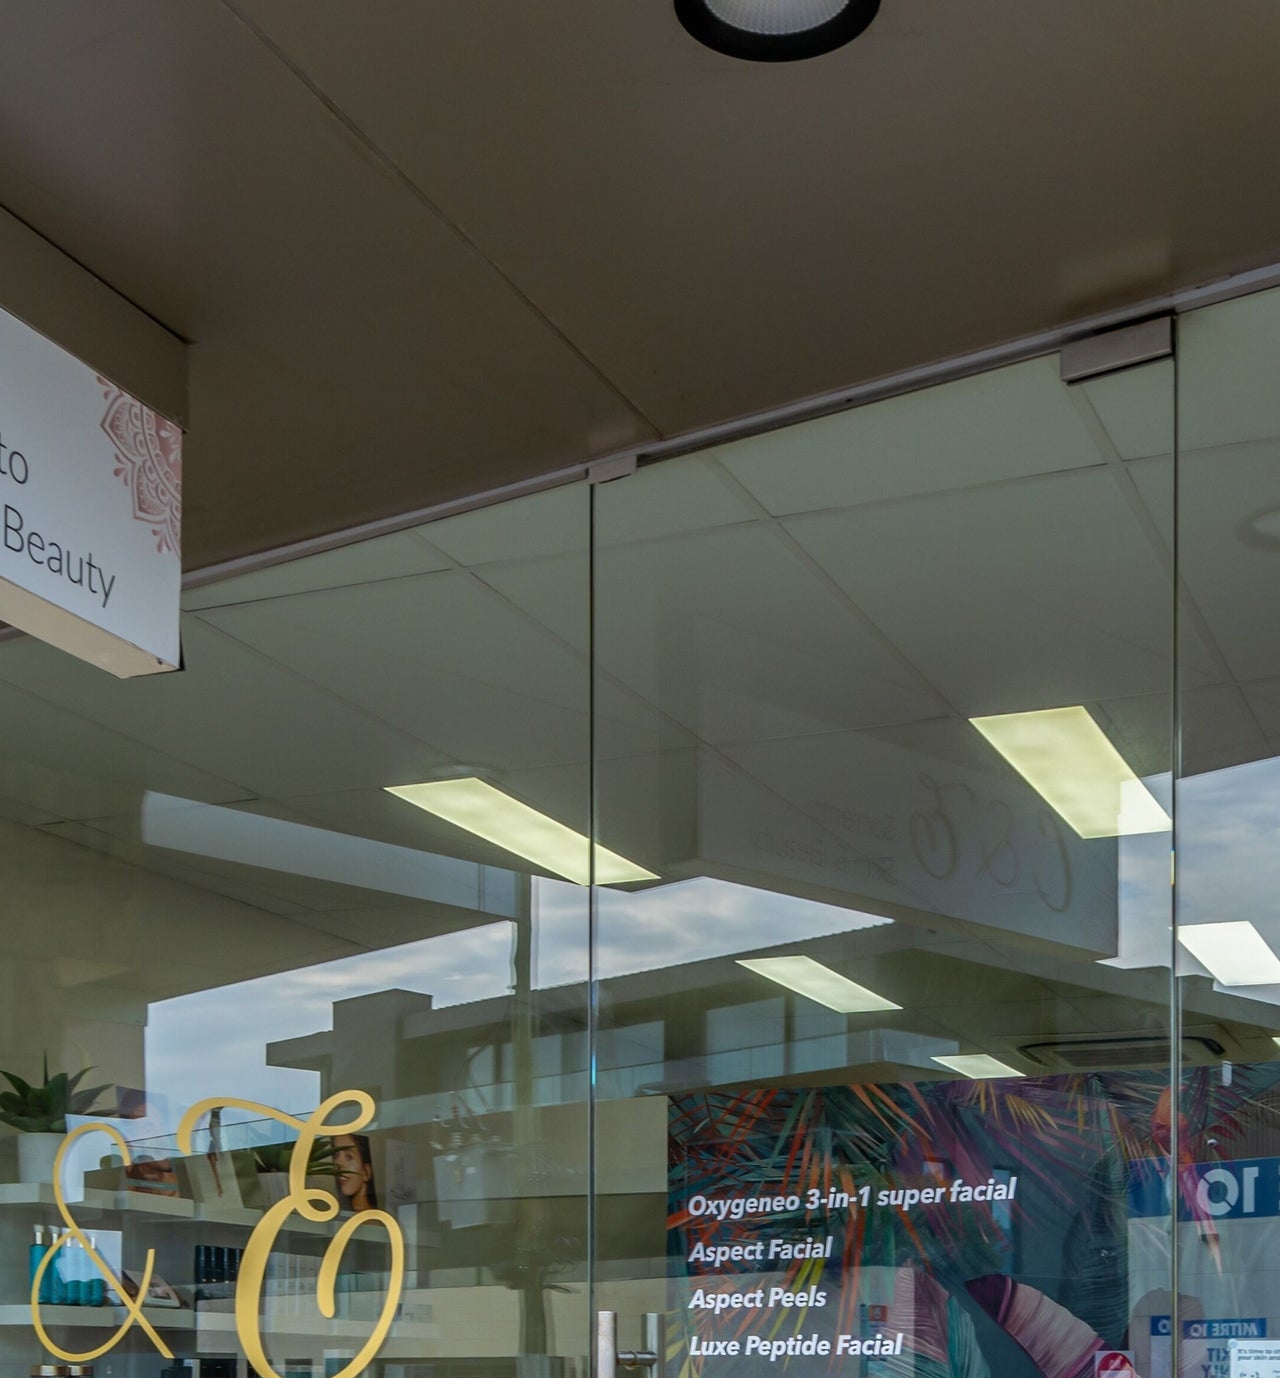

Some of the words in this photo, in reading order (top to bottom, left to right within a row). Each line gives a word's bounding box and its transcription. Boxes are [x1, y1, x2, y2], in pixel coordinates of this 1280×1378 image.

[4, 503, 116, 609] Beauty
[687, 1192, 800, 1220] Oxygeneo
[805, 1186, 871, 1210] 3-in-1
[877, 1185, 946, 1211] super
[950, 1176, 1018, 1202] facial
[31, 1122, 176, 1362] &
[687, 1240, 764, 1267] Aspect
[768, 1236, 833, 1260] Facial
[687, 1287, 764, 1314] Aspect
[768, 1285, 827, 1308] Peels
[689, 1335, 740, 1356] Luxe
[745, 1334, 830, 1362] Peptide
[835, 1333, 904, 1357] Facial
